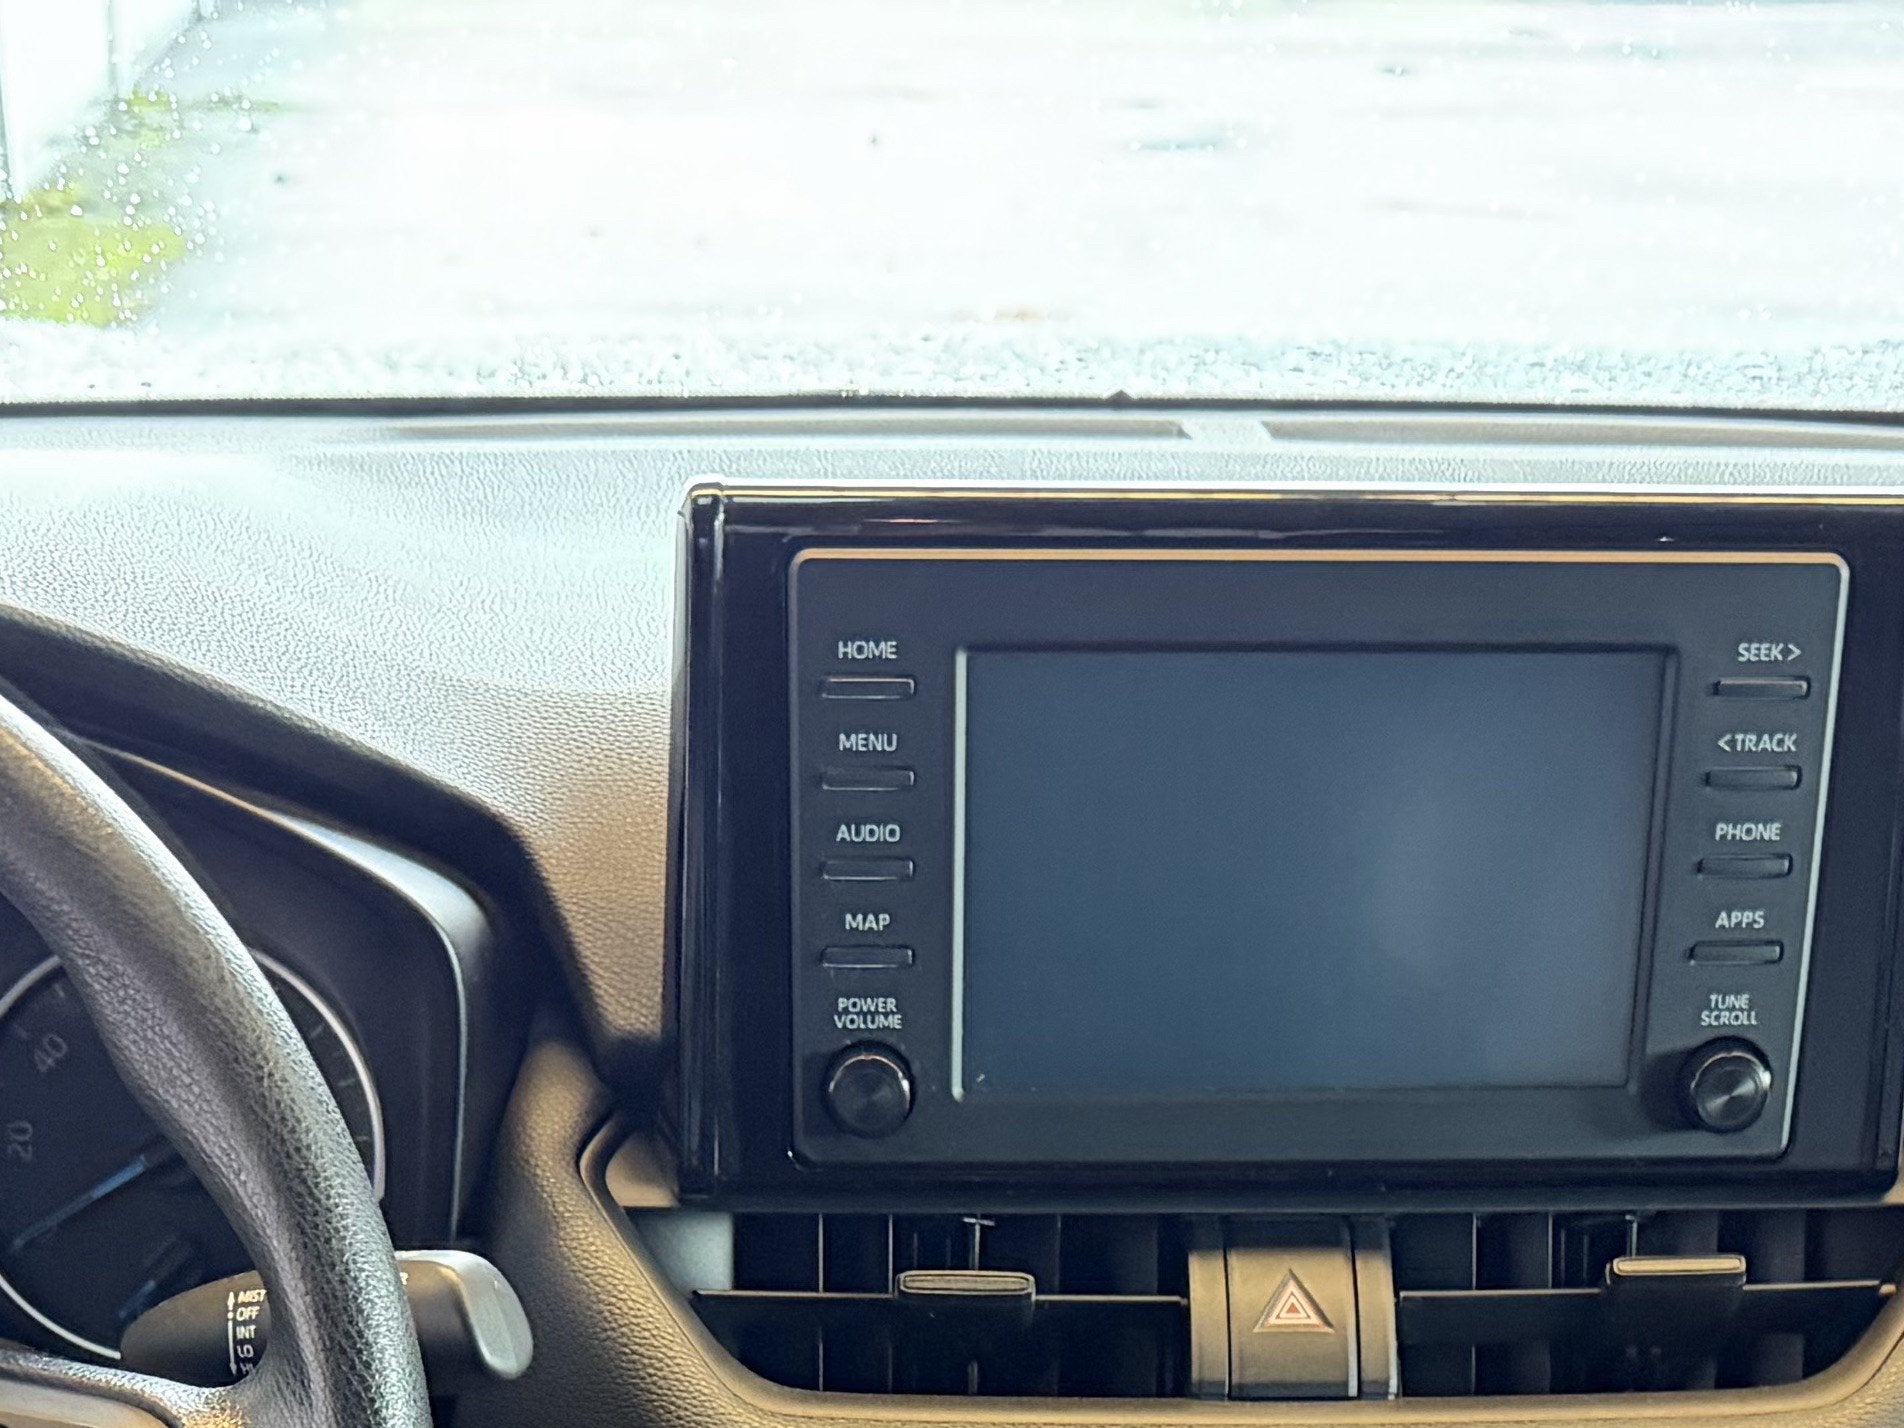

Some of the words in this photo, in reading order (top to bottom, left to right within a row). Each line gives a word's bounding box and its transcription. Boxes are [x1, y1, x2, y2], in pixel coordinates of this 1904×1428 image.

[837, 640, 898, 659] HOME
[838, 733, 898, 752] MENU
[835, 824, 901, 842] AUDIO
[1714, 823, 1782, 842] PHONE
[845, 913, 891, 931] MAP
[1715, 911, 1766, 929] APPS
[837, 997, 898, 1013] POWER
[1709, 994, 1750, 1010] TUNE
[833, 1014, 903, 1030] VOLUME
[1701, 1010, 1758, 1026] SCROLL
[34, 1033, 68, 1073] 40
[7, 1119, 34, 1162] 20
[236, 1306, 260, 1322] OFF
[236, 1325, 256, 1340] INT
